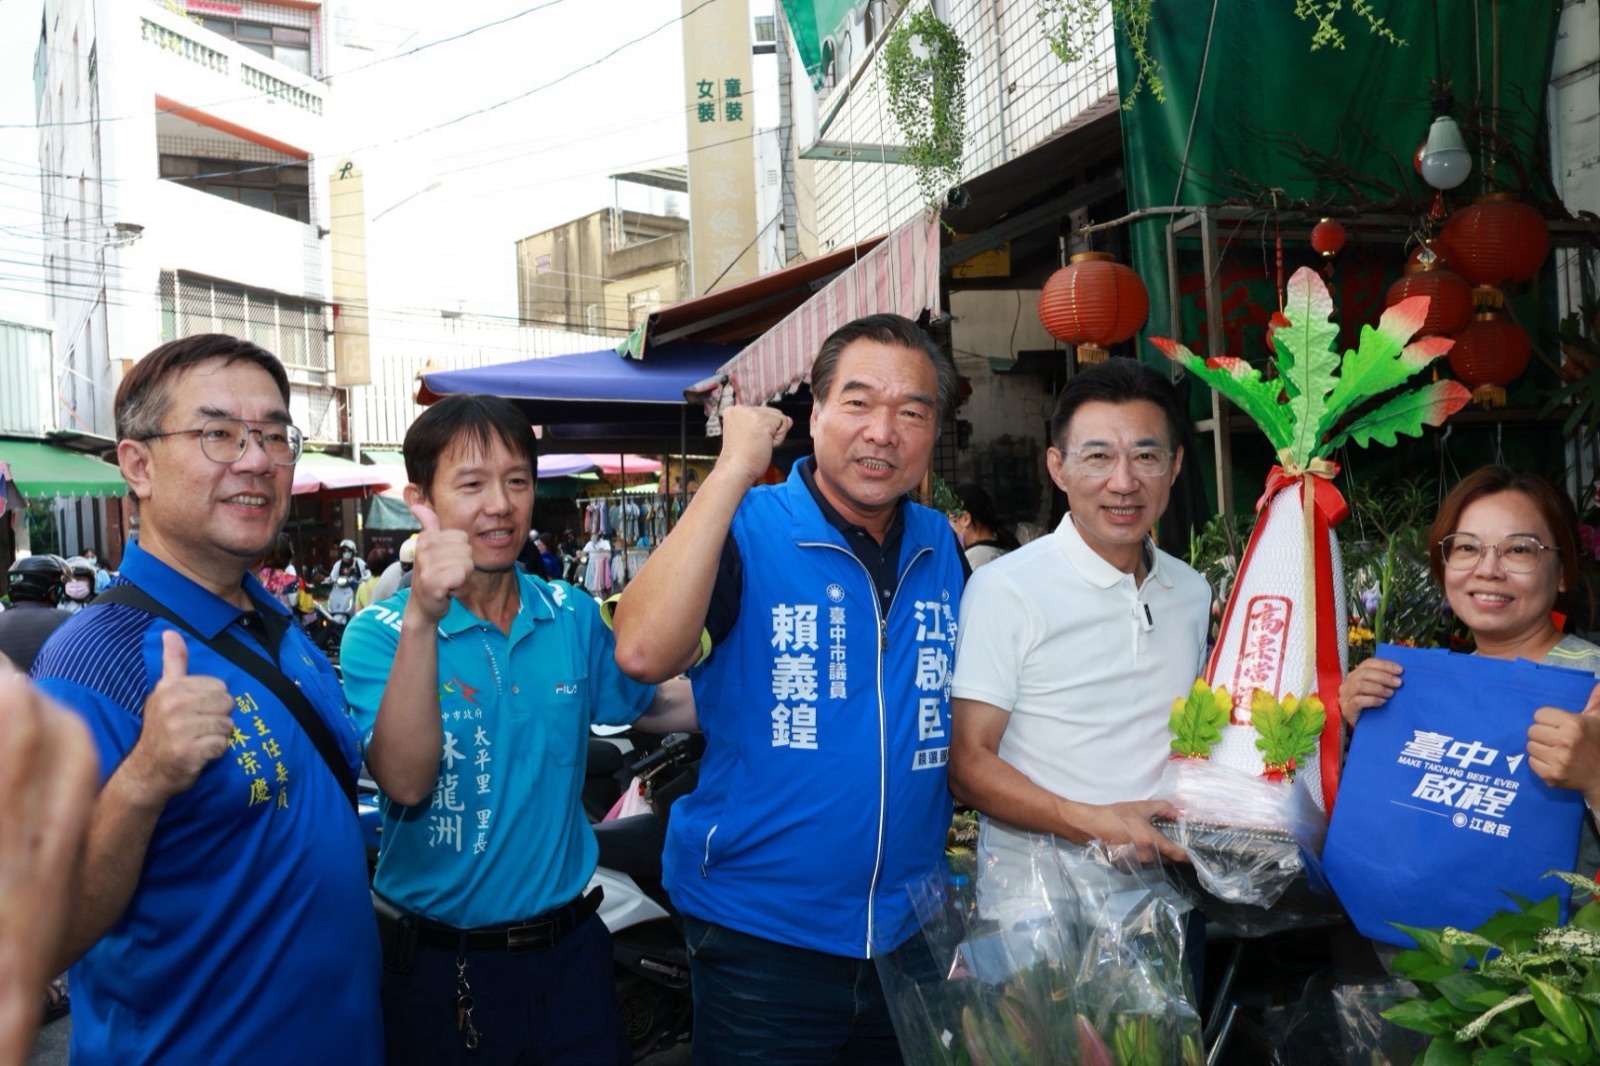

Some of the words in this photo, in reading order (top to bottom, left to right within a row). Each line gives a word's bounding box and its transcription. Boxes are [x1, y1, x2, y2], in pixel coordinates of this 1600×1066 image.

[696, 78, 716, 122] 女裝
[724, 78, 743, 122] 童裝
[828, 606, 848, 700] 臺中市議員
[555, 682, 577, 695] FILA
[770, 603, 819, 750] 賴義鍠
[441, 707, 483, 723] 中市政府
[226, 727, 272, 807] 林宗慶
[234, 691, 289, 810] 副主任委員
[473, 725, 492, 795] 太平里
[1399, 729, 1500, 769] 臺中
[1397, 755, 1423, 769] MAKE
[1423, 761, 1465, 778] TAICHUNG
[1466, 771, 1493, 784] BEST
[1493, 777, 1521, 791] EVER
[1410, 772, 1518, 819] 啟程
[473, 808, 492, 855] 里長
[1468, 817, 1512, 838] 江啟臣
